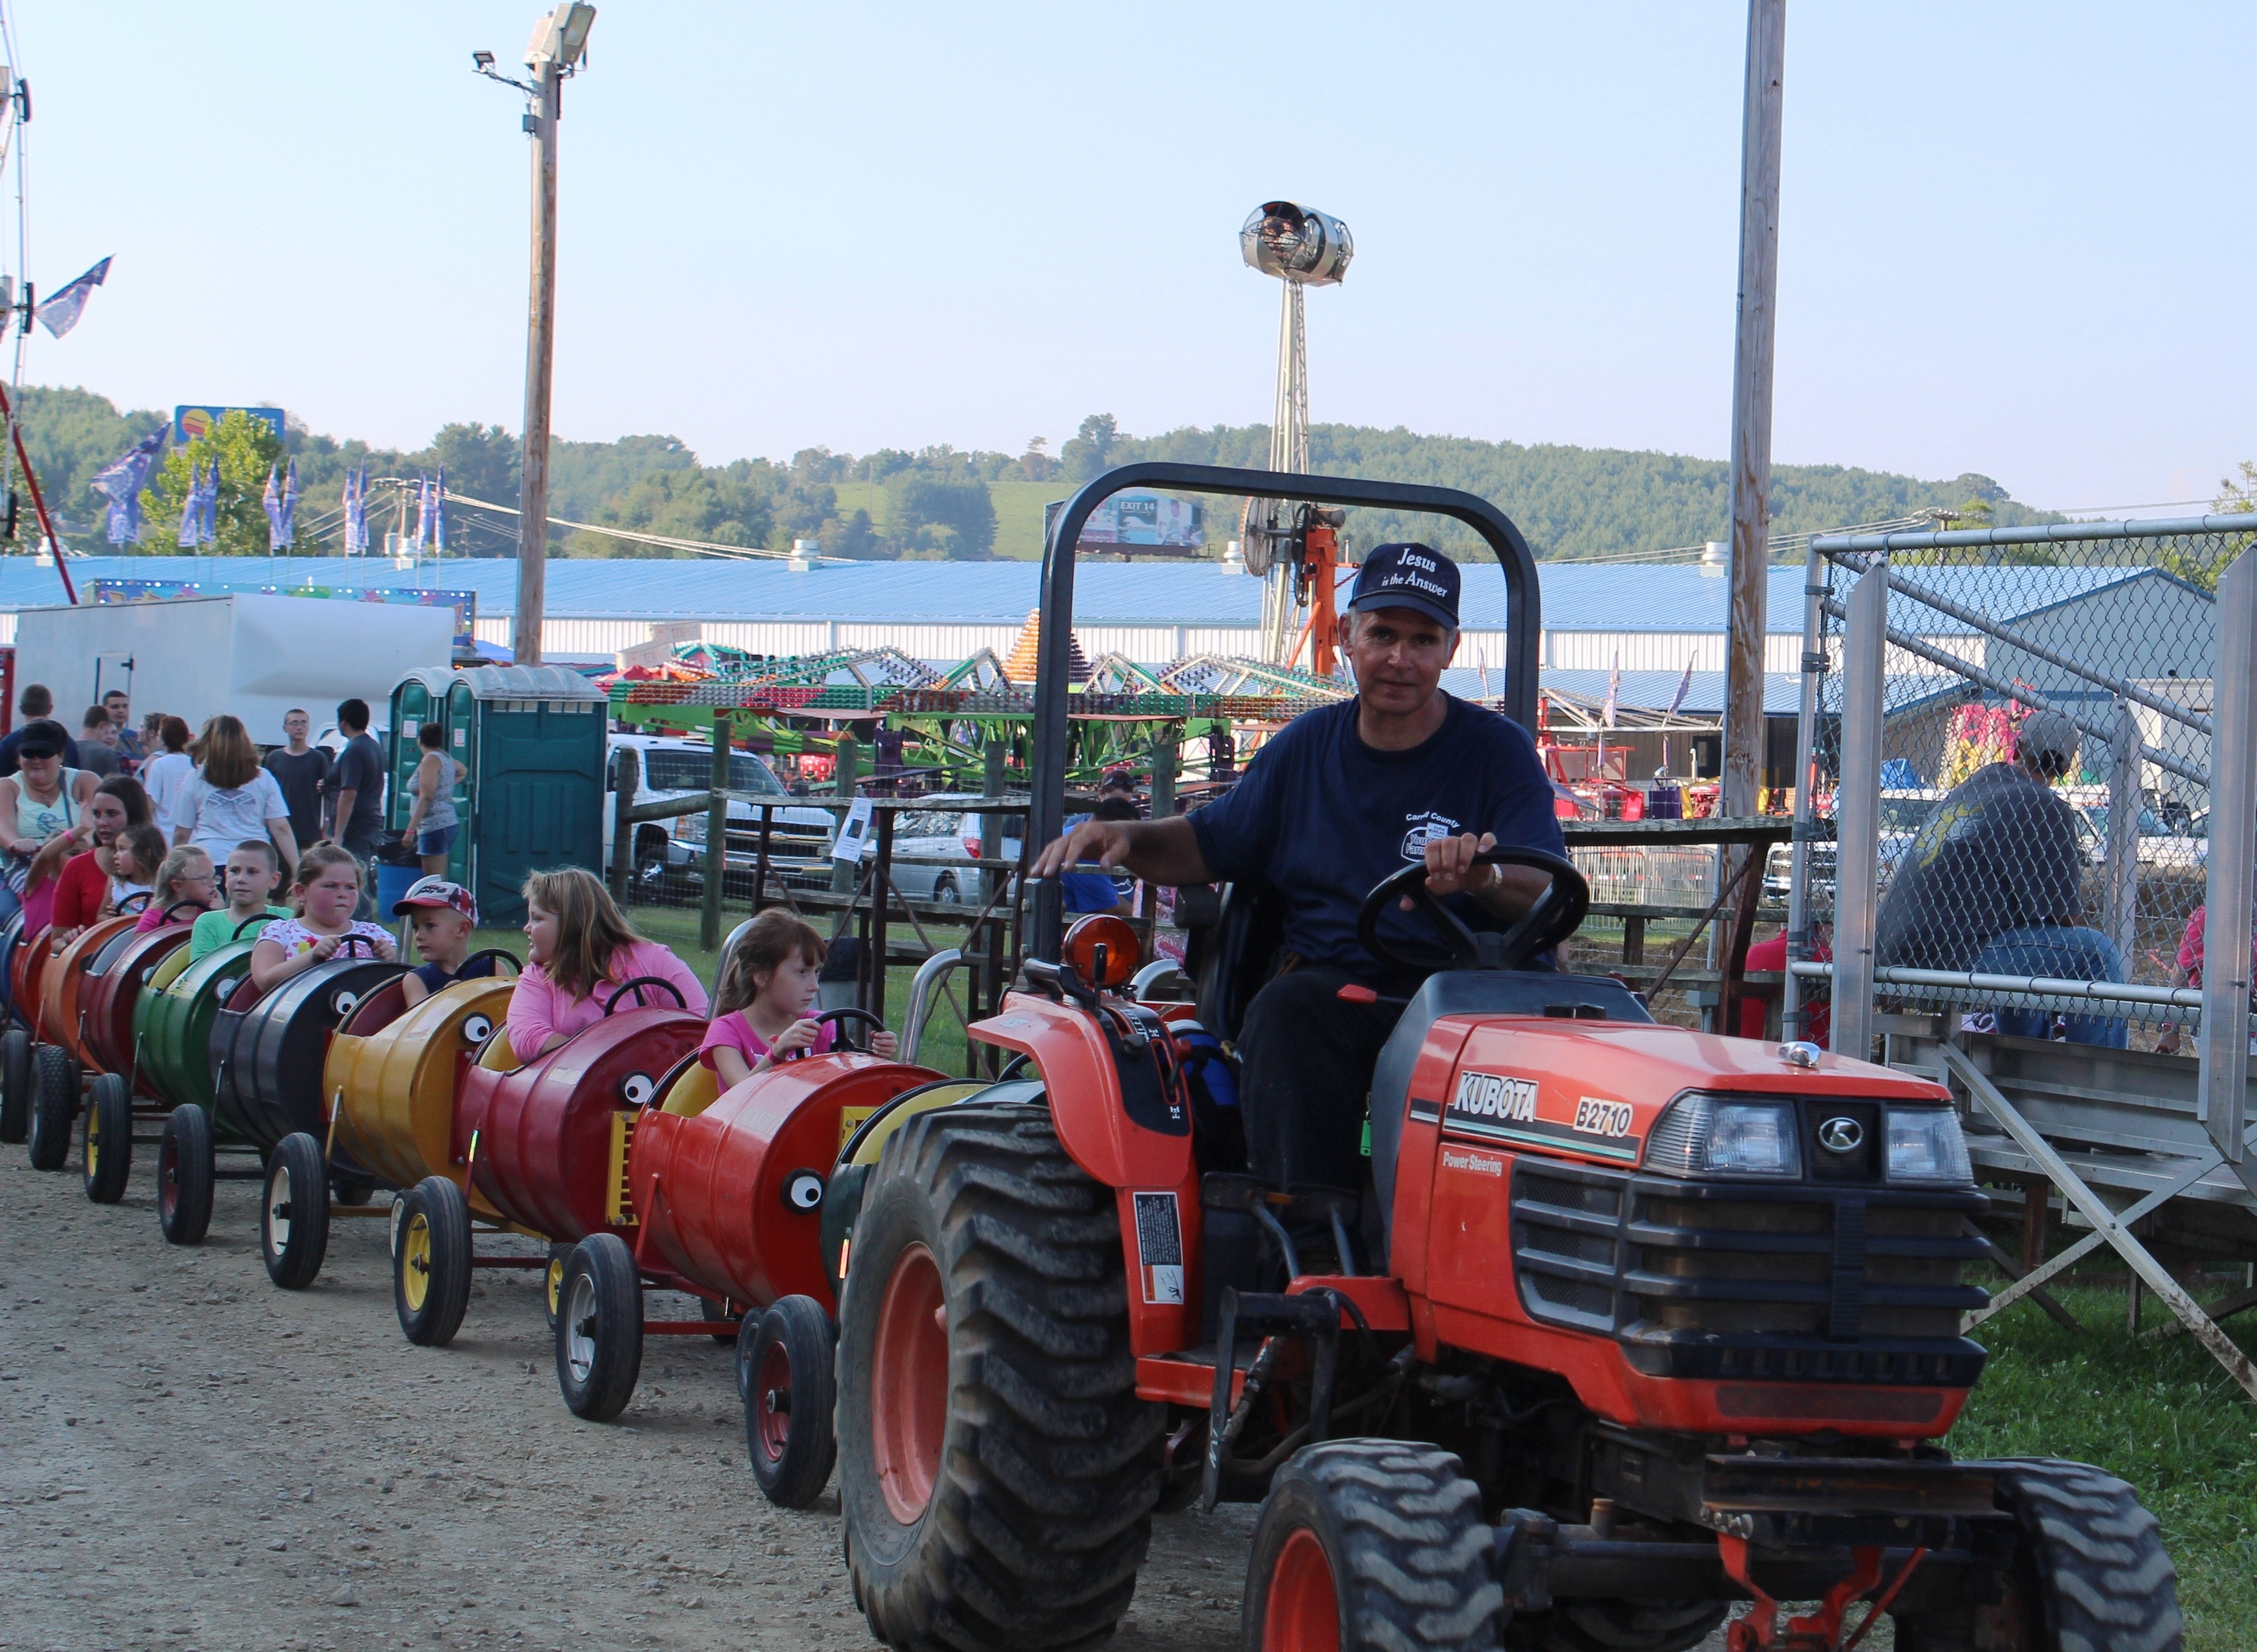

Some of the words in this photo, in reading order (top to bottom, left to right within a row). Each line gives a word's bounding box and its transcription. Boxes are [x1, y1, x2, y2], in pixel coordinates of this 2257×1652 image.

[1120, 501, 1142, 510] EXIT
[1397, 548, 1436, 573] Jesus
[1382, 576, 1389, 587] is
[1389, 574, 1403, 585] the
[1405, 571, 1448, 598] Answer
[1430, 812, 1461, 828] County
[1454, 1071, 1537, 1122] KUBOTA
[1576, 1101, 1632, 1133] B2710
[1443, 1151, 1468, 1169] Power
[1468, 1154, 1502, 1177] Steering
